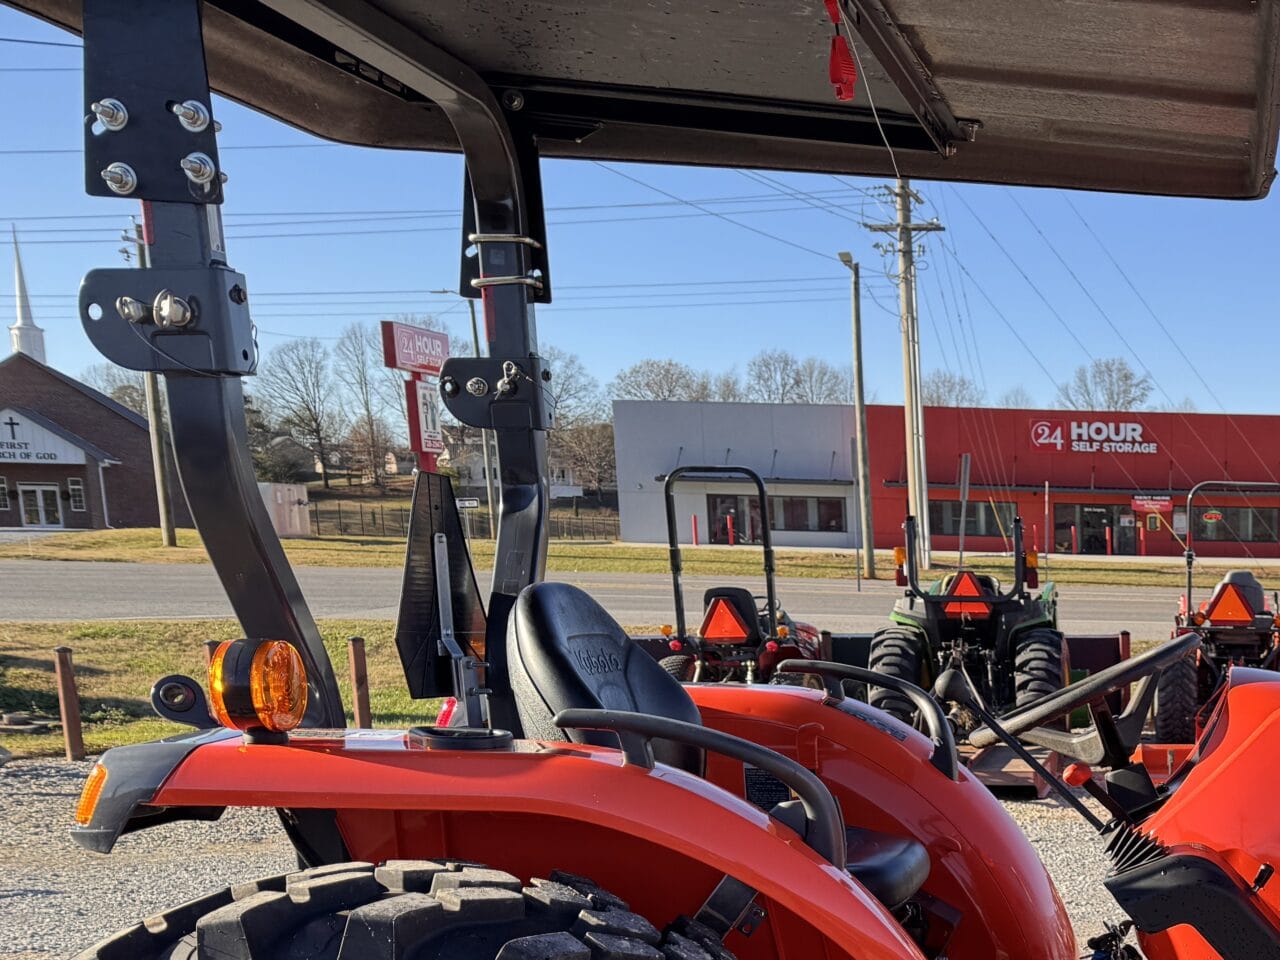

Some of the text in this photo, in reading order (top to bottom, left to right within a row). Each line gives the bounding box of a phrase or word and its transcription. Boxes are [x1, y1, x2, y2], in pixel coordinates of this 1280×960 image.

[402, 335, 442, 360] 24 HOUR
[1037, 421, 1143, 450] 24 HOUR
[20, 451, 32, 460] OF
[36, 452, 57, 461] GOD
[1071, 441, 1157, 454] SELF STORAGE
